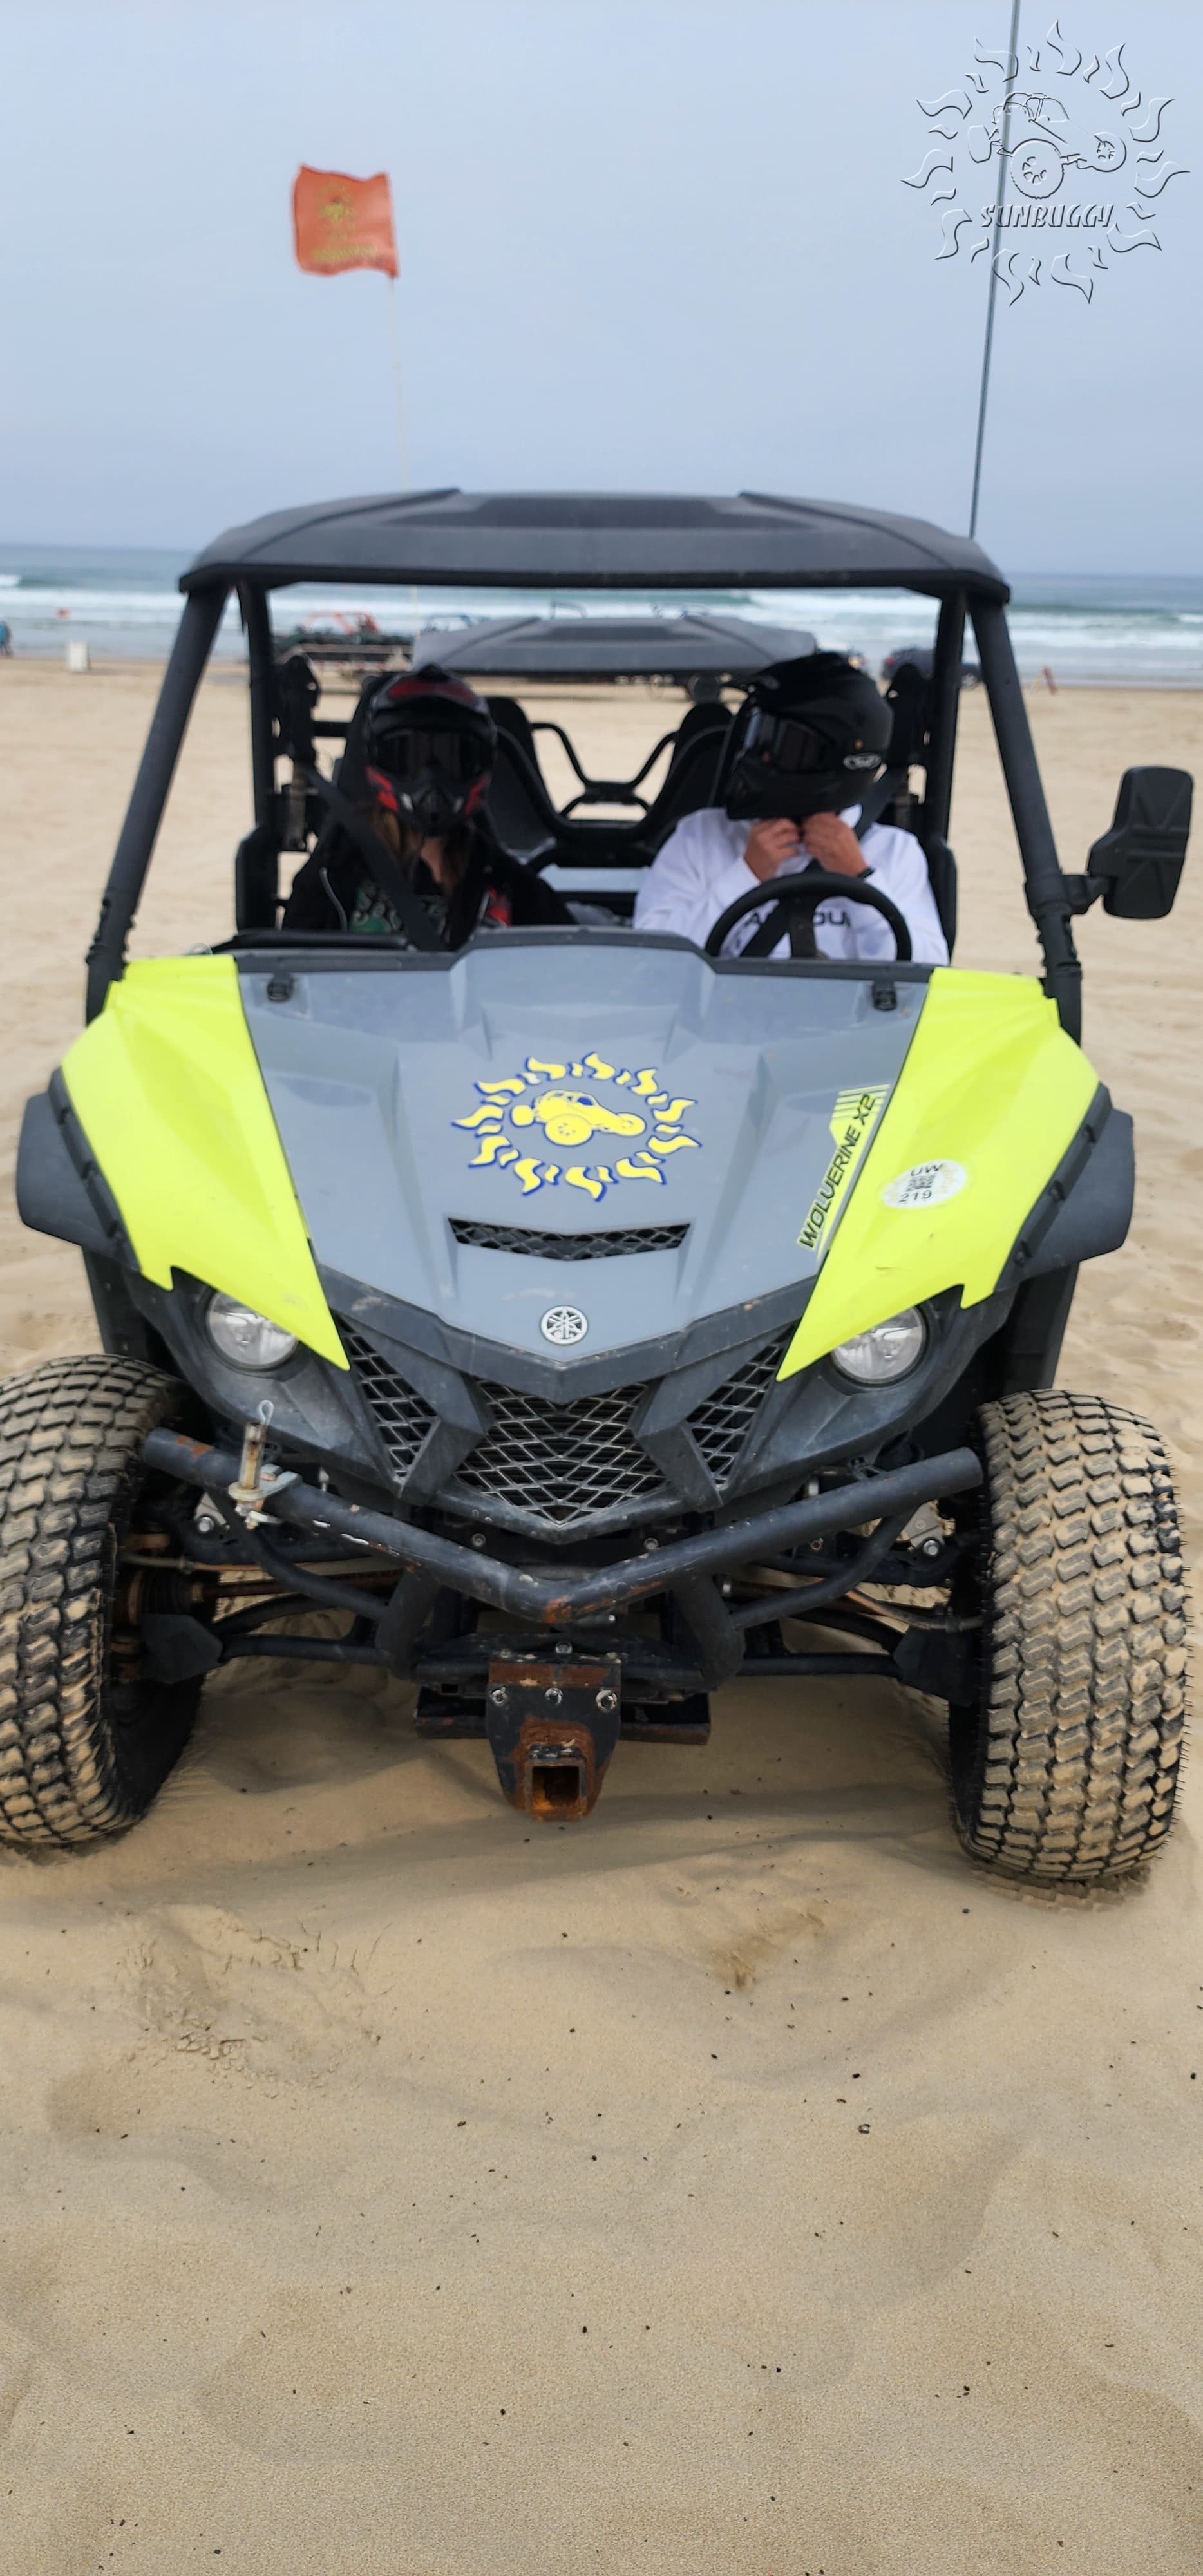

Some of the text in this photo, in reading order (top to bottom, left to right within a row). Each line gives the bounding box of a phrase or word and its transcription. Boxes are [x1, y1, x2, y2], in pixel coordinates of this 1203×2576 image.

[799, 1094, 876, 1248] WOLVERINE X2
[909, 1162, 943, 1176] UW
[897, 1189, 933, 1202] 219
